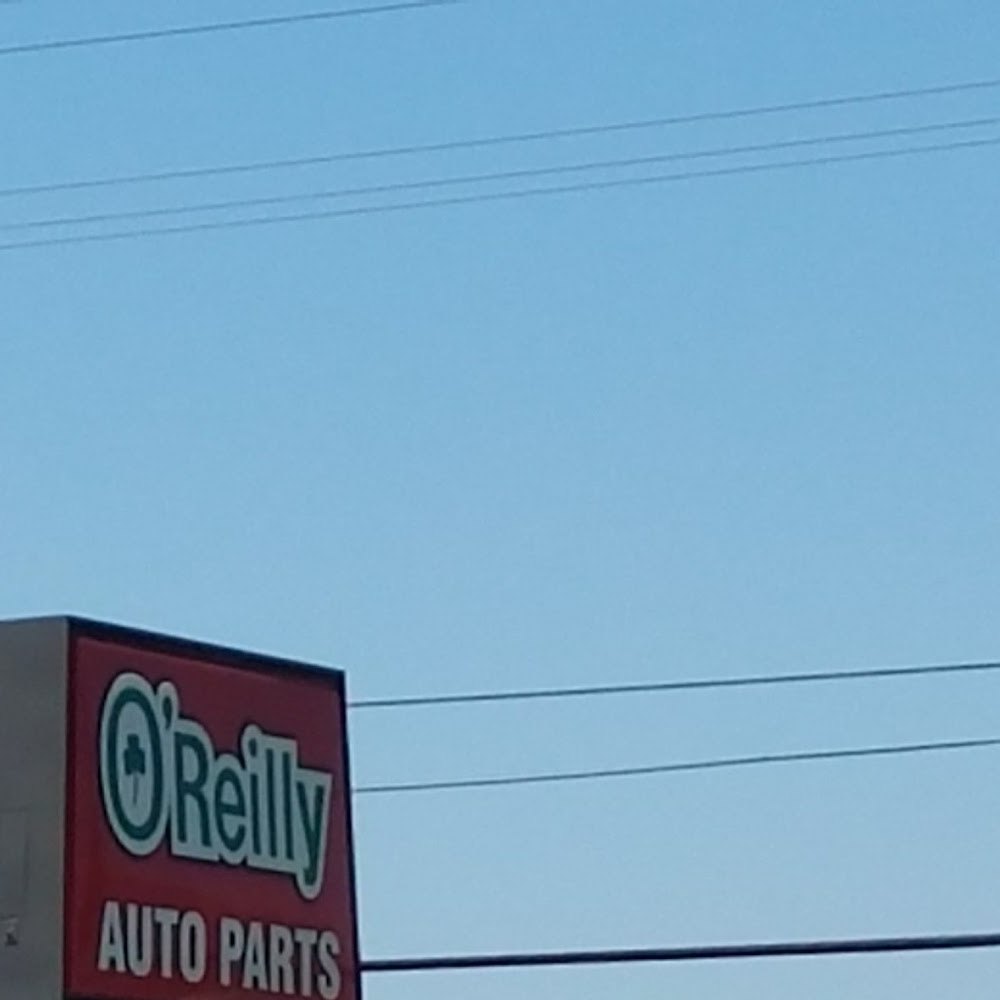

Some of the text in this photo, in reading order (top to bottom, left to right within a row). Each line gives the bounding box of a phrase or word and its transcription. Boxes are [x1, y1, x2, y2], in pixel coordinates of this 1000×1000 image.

[104, 678, 328, 893] O'Reilly
[98, 901, 341, 1000] AUTO PARTS
